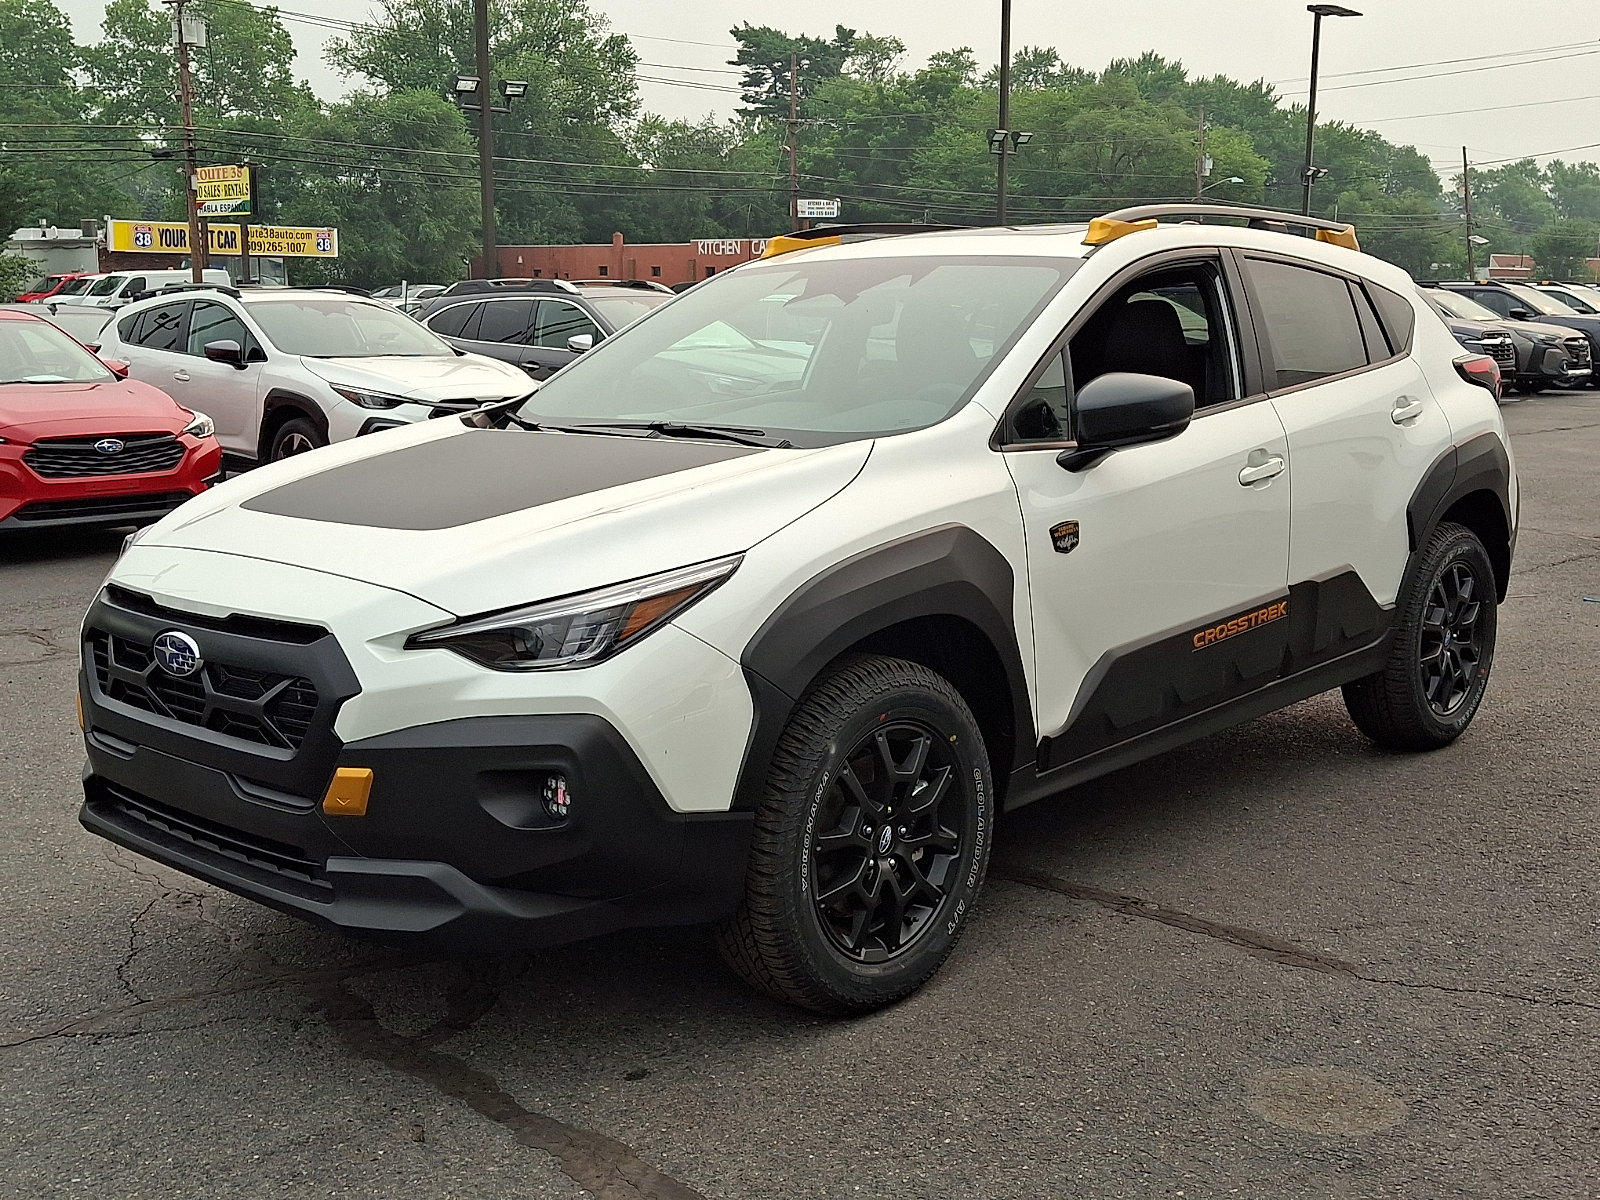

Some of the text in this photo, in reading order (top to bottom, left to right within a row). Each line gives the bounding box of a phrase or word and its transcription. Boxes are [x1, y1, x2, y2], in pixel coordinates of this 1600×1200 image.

[231, 167, 243, 179] 38
[203, 184, 221, 198] SALES
[224, 182, 249, 197] RENTALS
[136, 232, 152, 246] 38
[158, 228, 187, 248] YOUR
[217, 230, 238, 249] CAR
[247, 228, 313, 241] ute38auto.com
[317, 238, 331, 251] 38
[698, 240, 769, 256] KITCHEN CA
[1192, 601, 1288, 649] CROSSTREK
[800, 771, 830, 892] YOKOHAMA
[966, 767, 986, 889] GEOLANDAR
